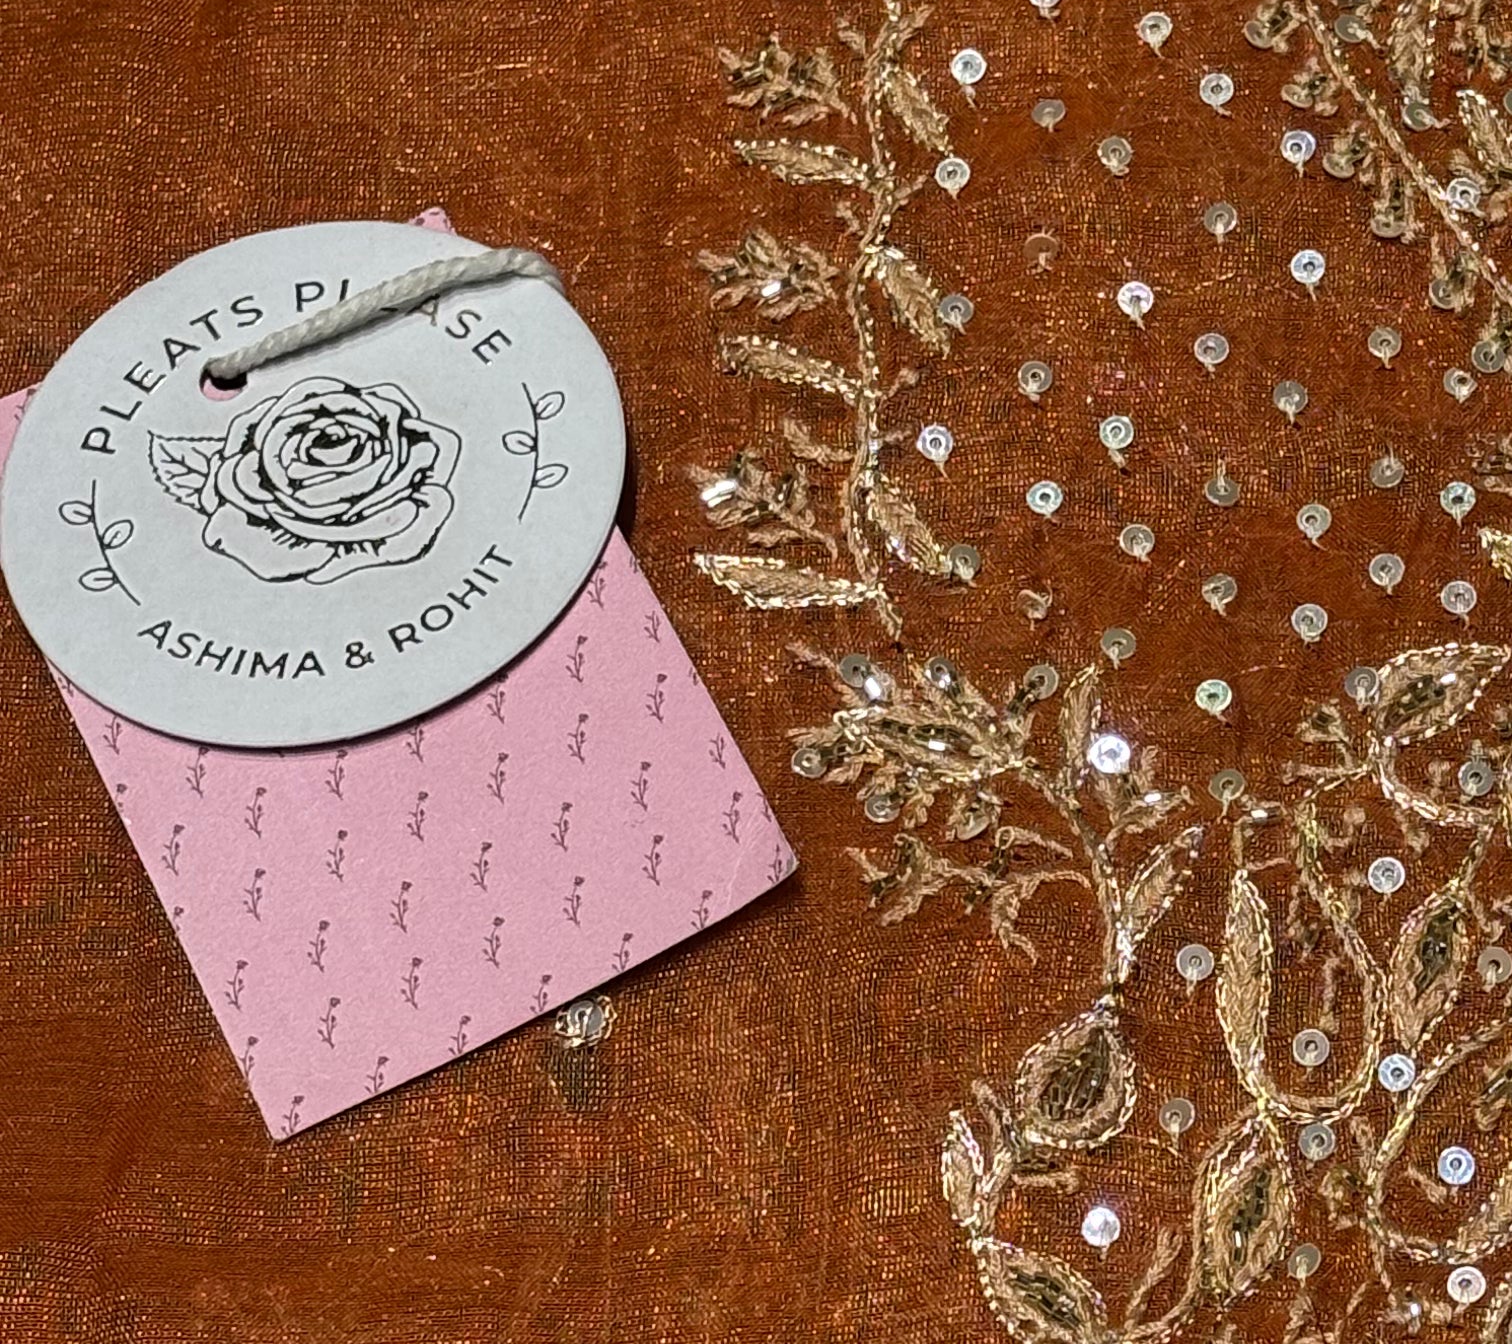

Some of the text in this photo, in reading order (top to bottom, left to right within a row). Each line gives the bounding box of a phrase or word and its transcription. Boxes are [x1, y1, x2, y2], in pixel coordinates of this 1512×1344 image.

[82, 279, 513, 455] PLEATS PASE
[138, 545, 514, 678] ASHIMA & ROHIT
